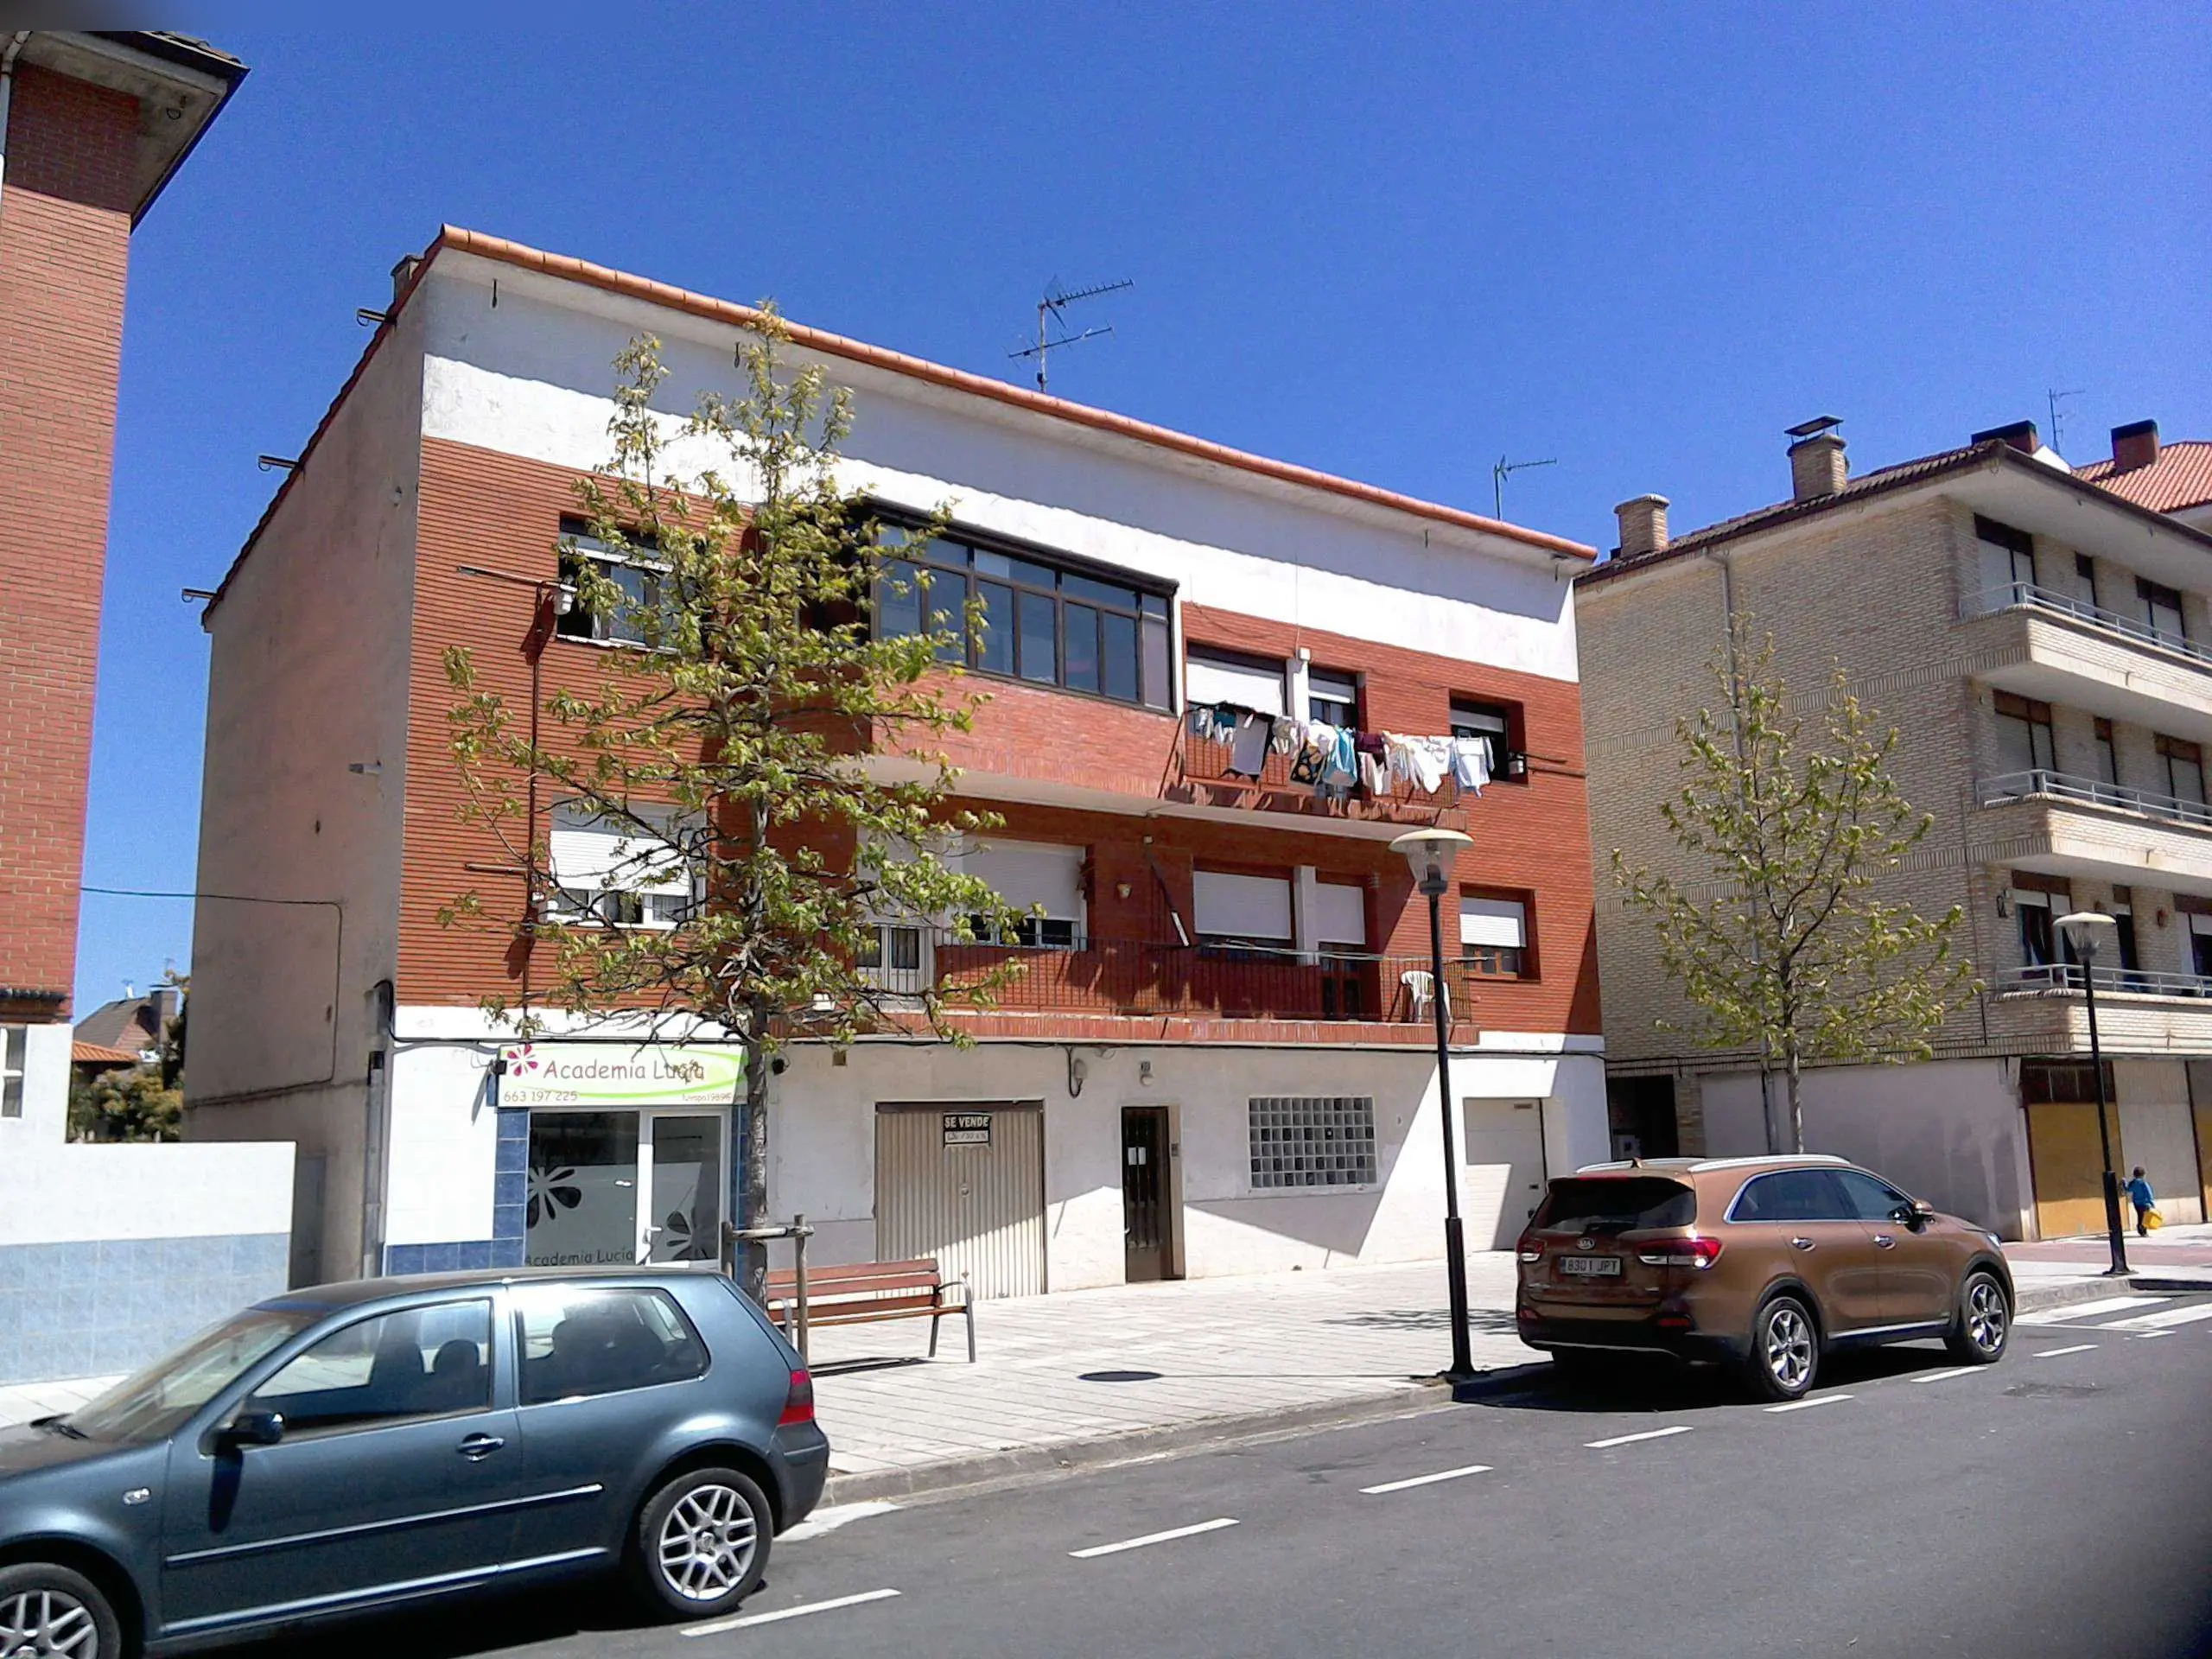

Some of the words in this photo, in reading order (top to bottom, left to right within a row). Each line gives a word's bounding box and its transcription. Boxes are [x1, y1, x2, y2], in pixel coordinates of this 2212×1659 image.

[543, 1058, 645, 1079] Academia
[504, 1090, 526, 1102] 663
[531, 1090, 551, 1102] 197
[556, 1090, 577, 1101] 225
[944, 1116, 957, 1128] SE
[959, 1116, 989, 1128] VENDE
[524, 1251, 593, 1266] Academia
